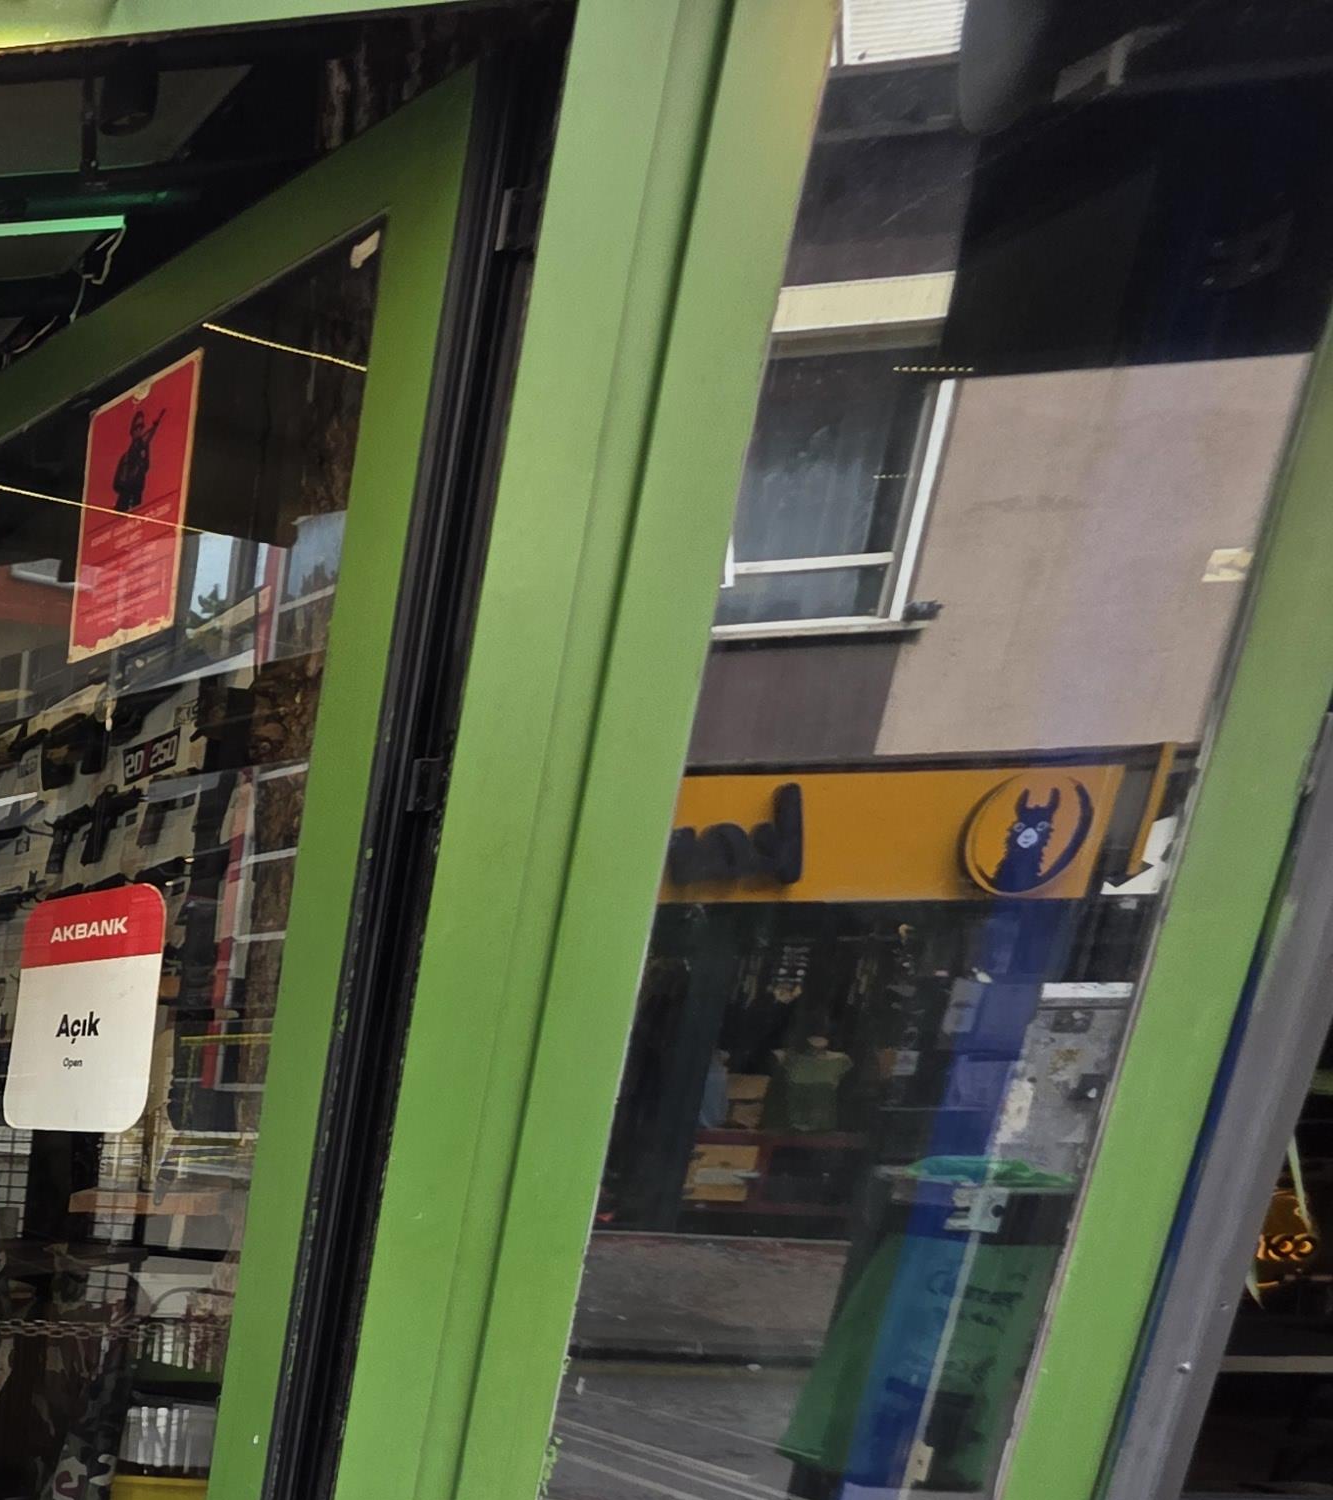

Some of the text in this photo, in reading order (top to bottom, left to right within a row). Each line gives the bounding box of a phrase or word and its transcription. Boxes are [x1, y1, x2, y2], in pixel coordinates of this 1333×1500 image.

[50, 916, 130, 943] AKBANK
[55, 1010, 100, 1043] Açık
[62, 1057, 83, 1069] Open
